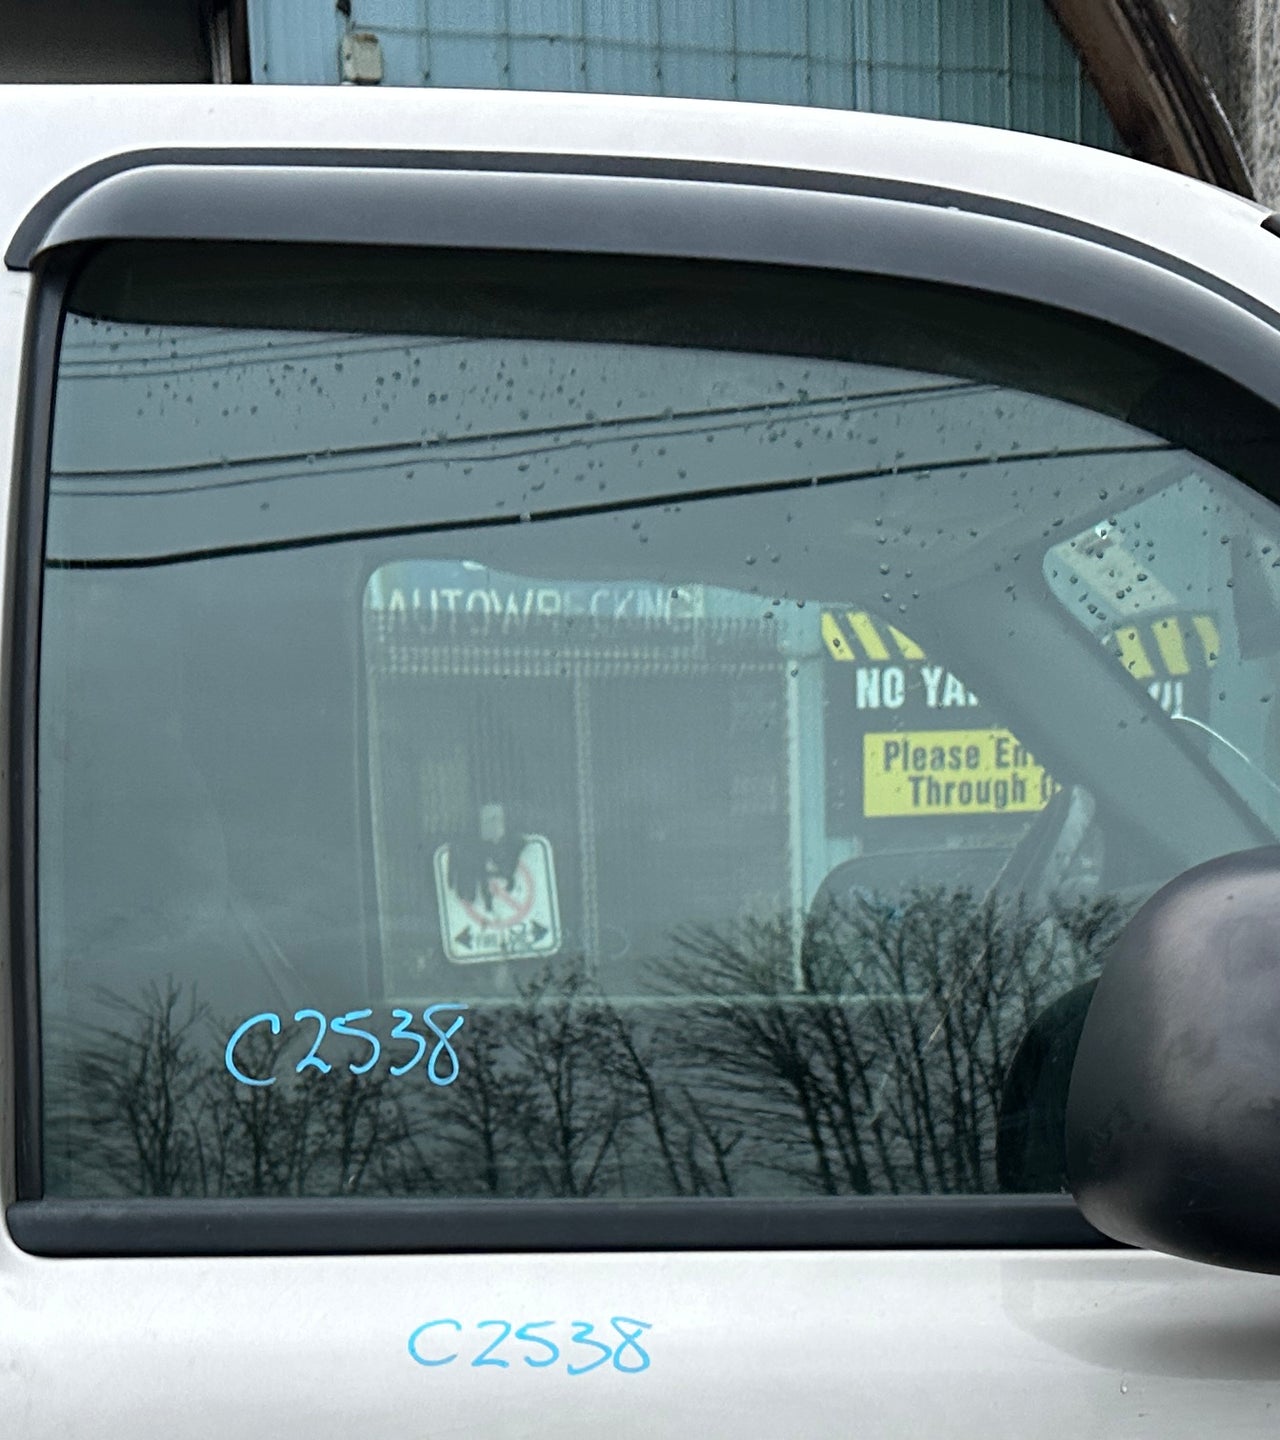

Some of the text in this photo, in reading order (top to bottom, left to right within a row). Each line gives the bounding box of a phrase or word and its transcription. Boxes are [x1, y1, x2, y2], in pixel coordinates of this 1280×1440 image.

[855, 665, 979, 709] NO YA
[882, 740, 981, 772] Please
[907, 775, 1027, 809] Through
[224, 1002, 469, 1087] C2538
[407, 1315, 653, 1376] C2538
